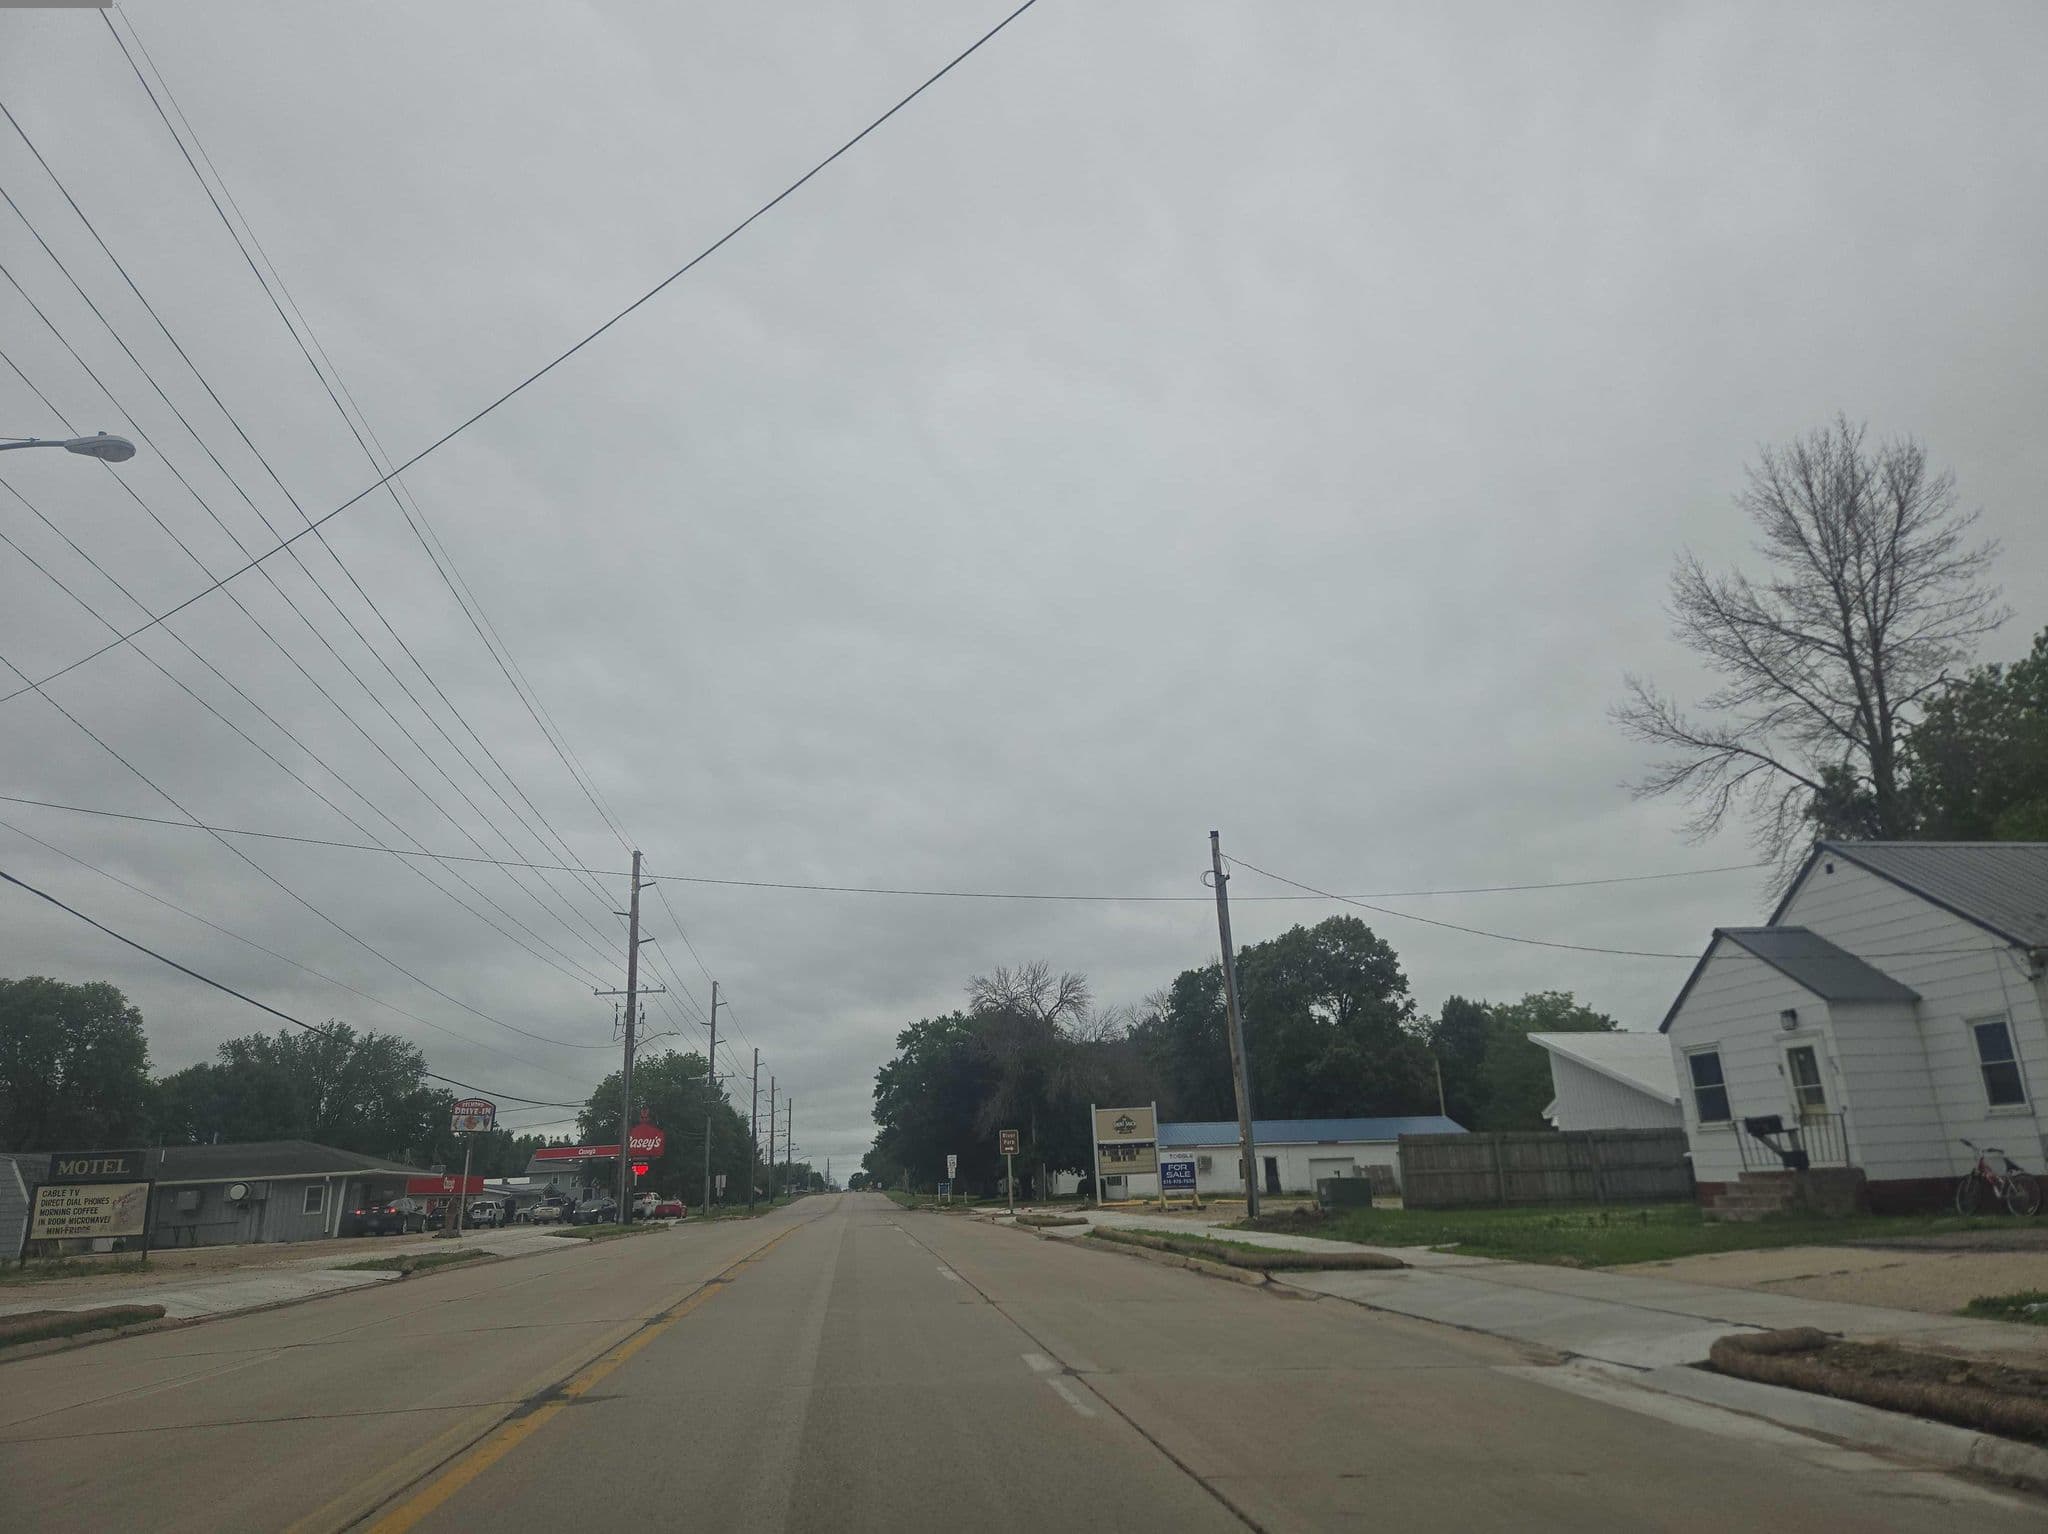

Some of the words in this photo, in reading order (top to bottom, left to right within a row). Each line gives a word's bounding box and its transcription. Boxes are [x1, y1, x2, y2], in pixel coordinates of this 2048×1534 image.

[454, 1107, 491, 1115] DRIVE-IN
[629, 1136, 661, 1151] asey's
[57, 1159, 130, 1176] MOTEL
[1168, 1163, 1188, 1171] FOR
[1166, 1171, 1191, 1179] SALE
[42, 1189, 67, 1198] CABLE
[70, 1189, 80, 1197] TV
[40, 1198, 65, 1208] DIRECT
[66, 1198, 82, 1207] DIAL
[83, 1197, 110, 1206] PHONES
[40, 1207, 71, 1217] MORNING
[73, 1206, 99, 1215] COFFEE
[47, 1217, 66, 1226] ROOM
